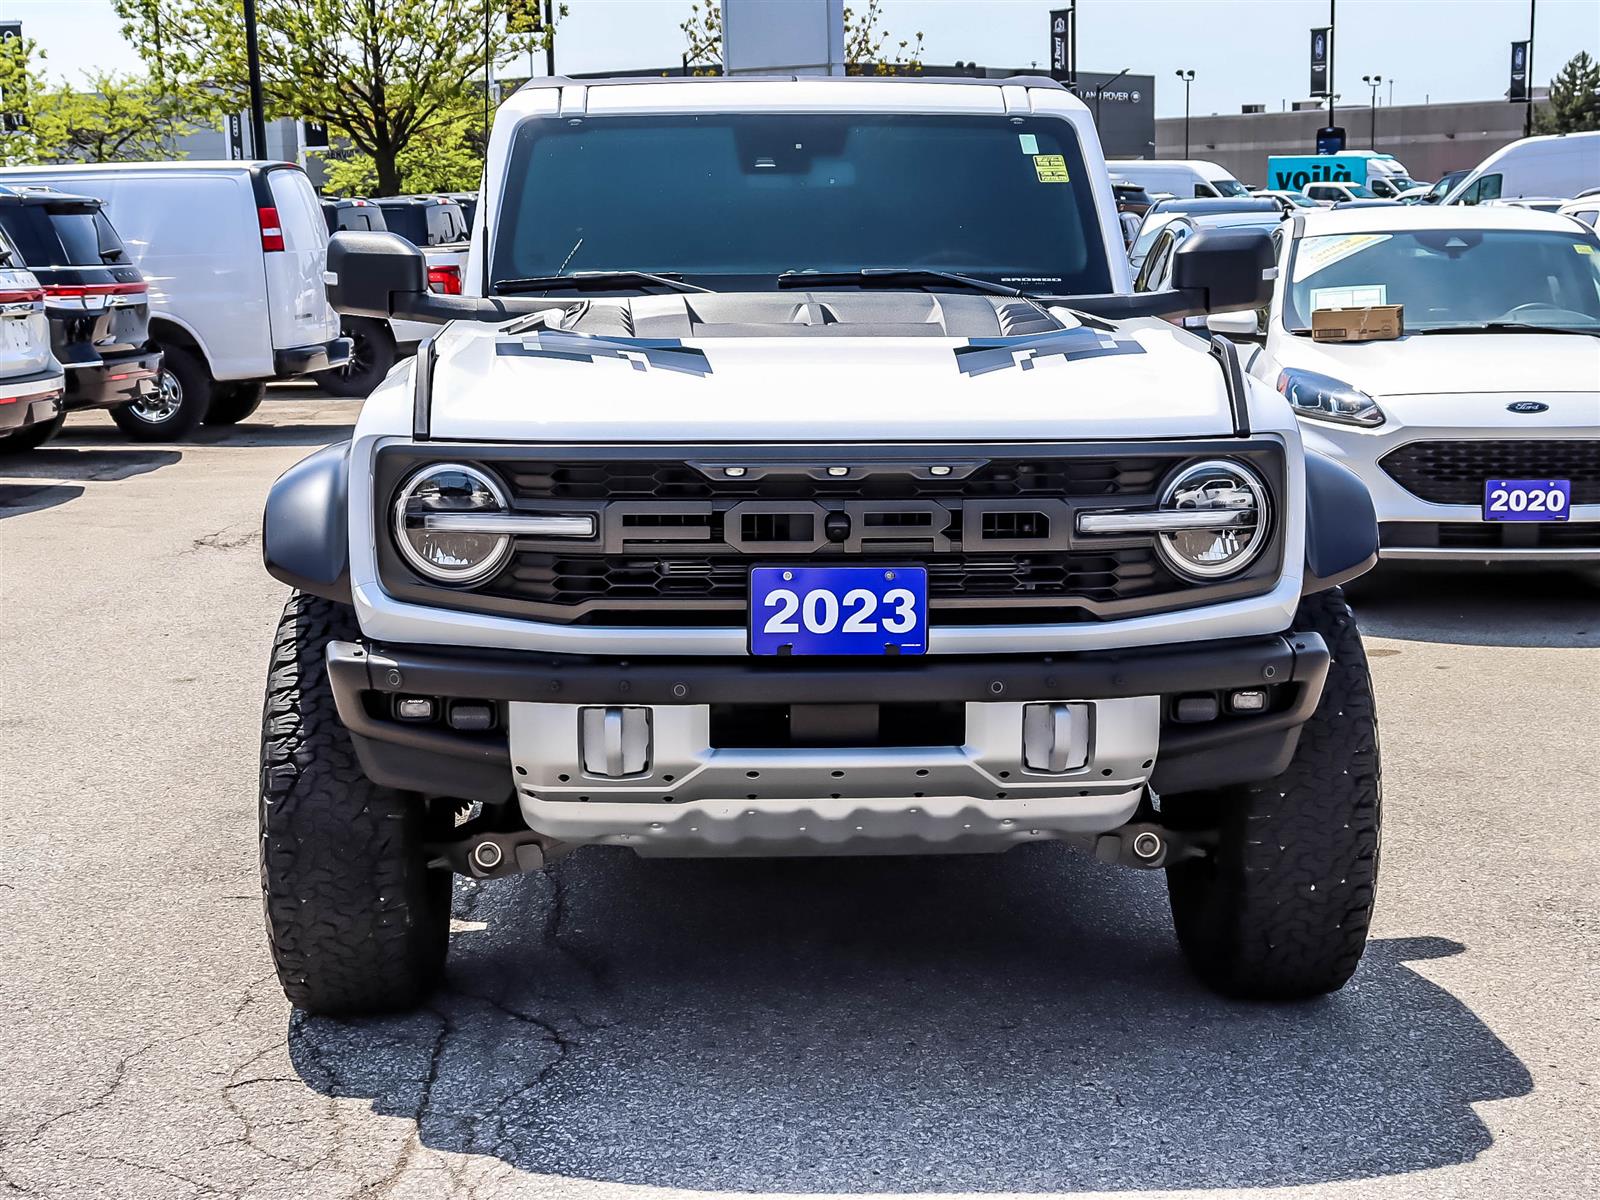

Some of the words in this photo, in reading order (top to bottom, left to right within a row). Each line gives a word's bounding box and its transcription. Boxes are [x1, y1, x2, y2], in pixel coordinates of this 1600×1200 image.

[1103, 91, 1129, 101] ROVER
[1276, 164, 1352, 190] voilà
[1490, 489, 1566, 512] 2020
[604, 498, 1071, 554] FORD
[763, 588, 917, 634] 2023
